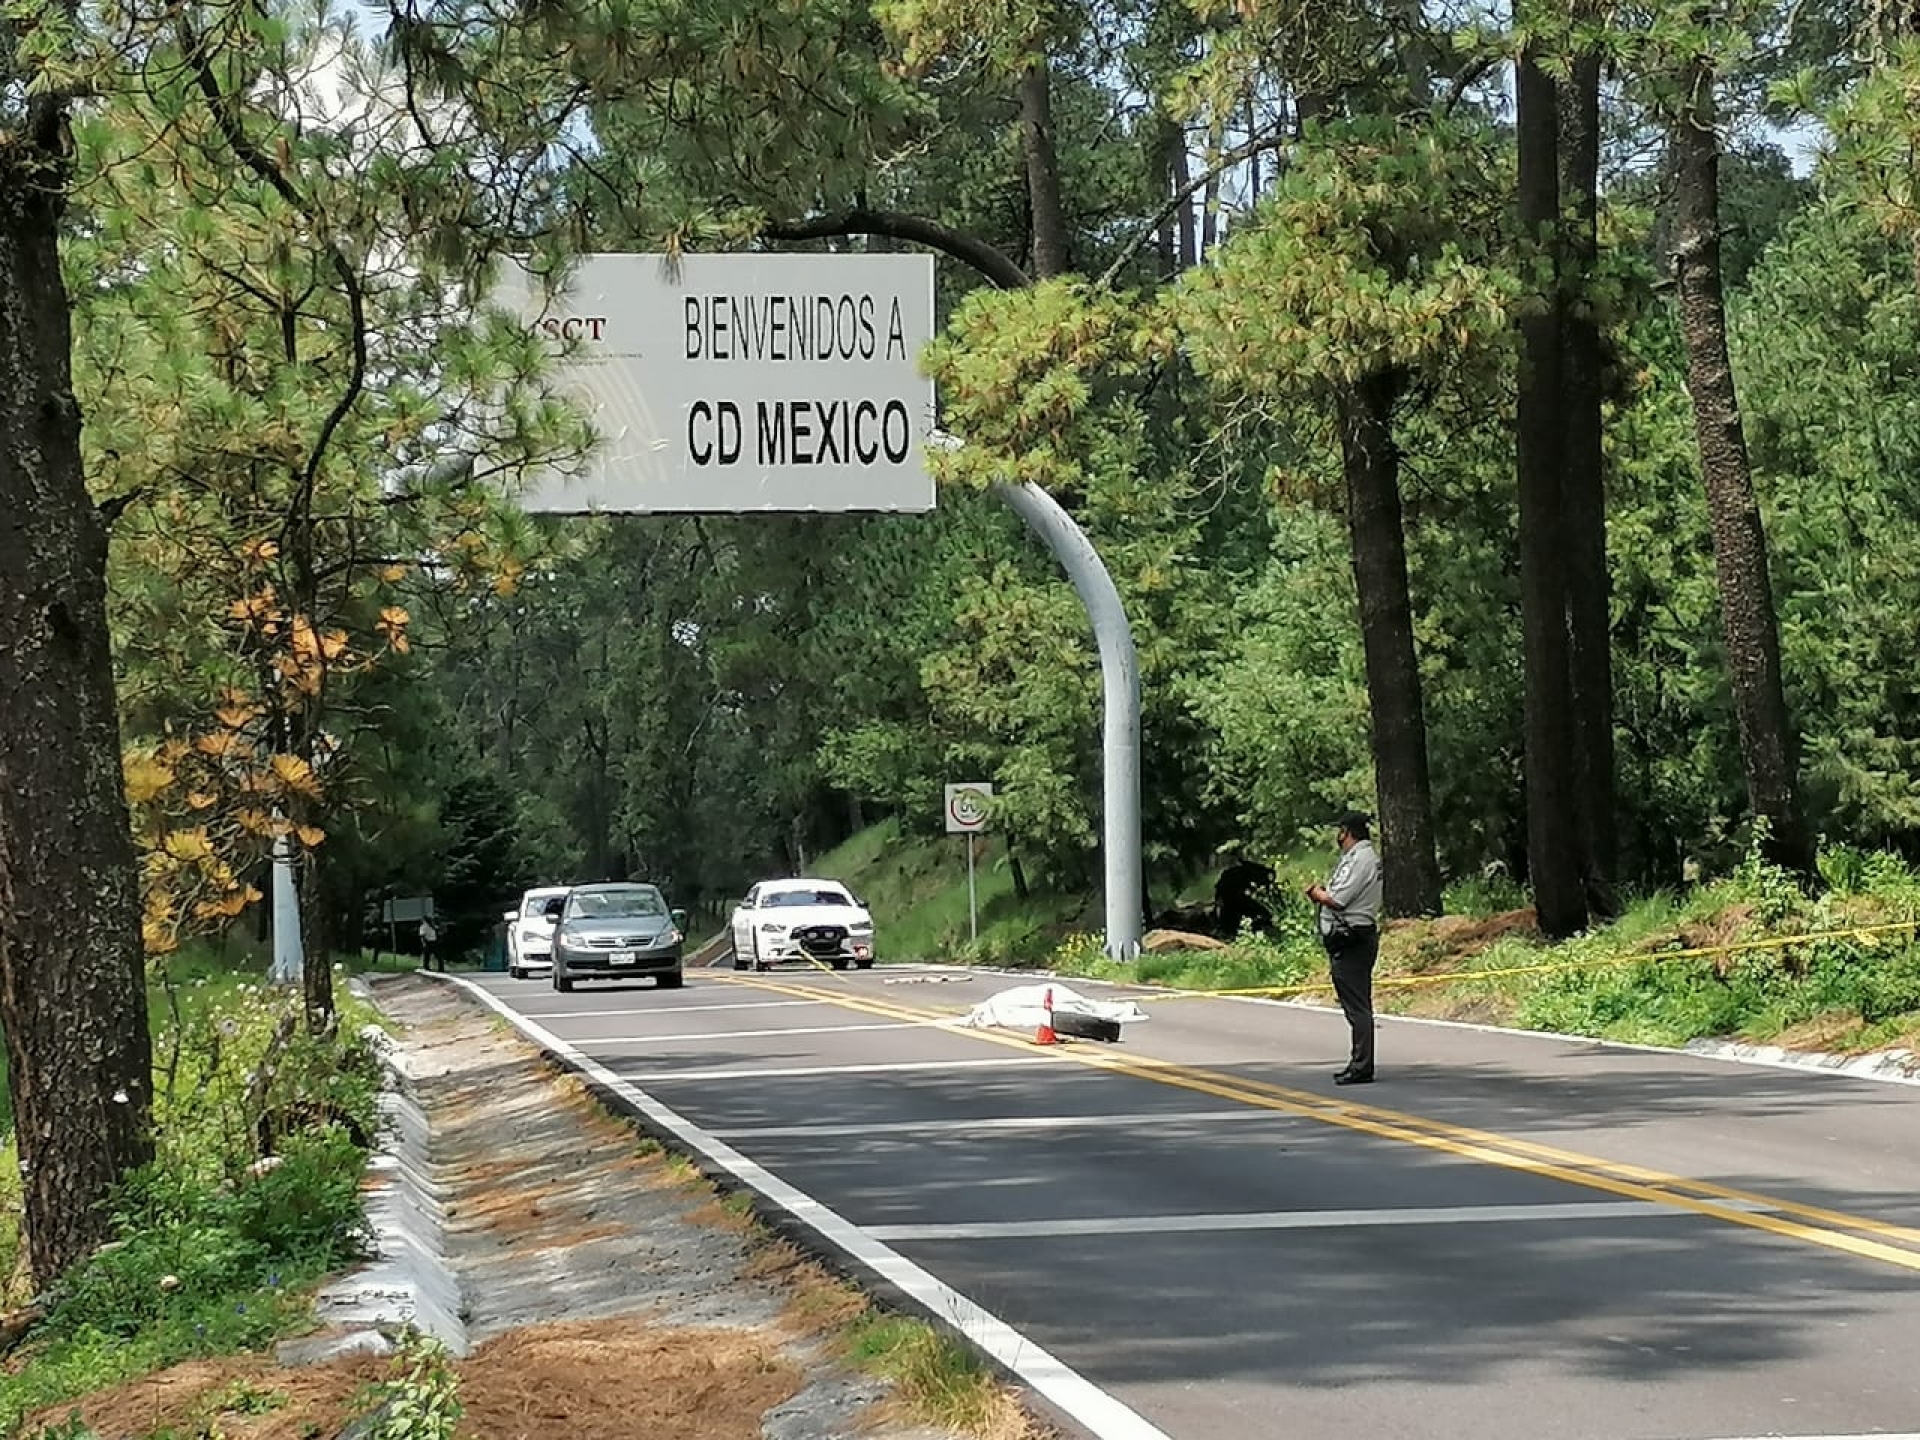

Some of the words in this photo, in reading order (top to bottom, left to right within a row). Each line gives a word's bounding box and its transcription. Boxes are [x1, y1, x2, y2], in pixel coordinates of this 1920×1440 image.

[542, 317, 607, 341] SCT
[685, 294, 875, 361] BIENVENIDOS
[886, 295, 906, 361] A
[688, 400, 742, 465] CD
[756, 399, 910, 465] MEXICO
